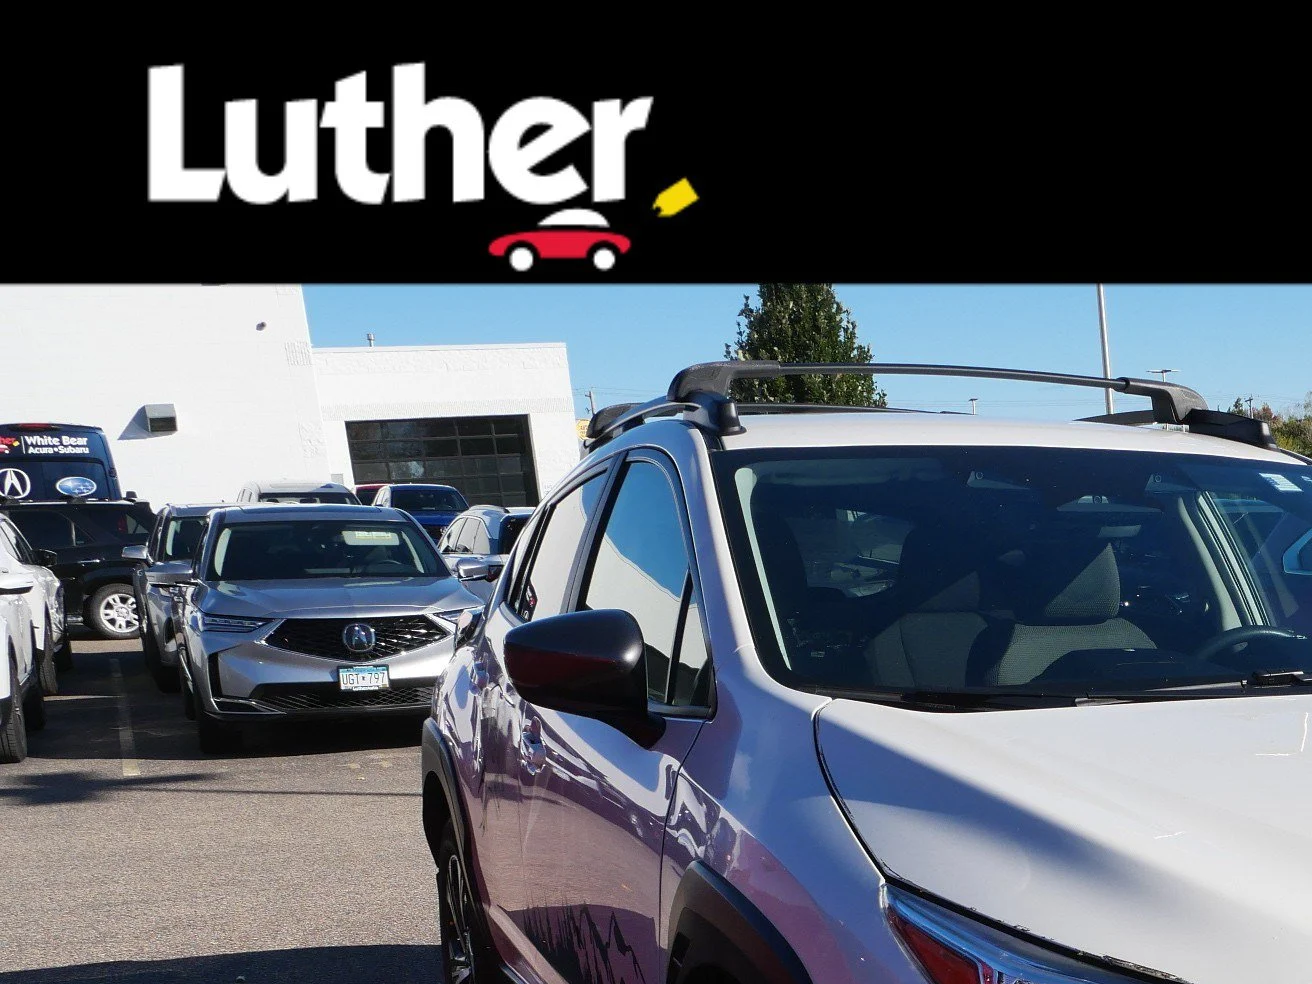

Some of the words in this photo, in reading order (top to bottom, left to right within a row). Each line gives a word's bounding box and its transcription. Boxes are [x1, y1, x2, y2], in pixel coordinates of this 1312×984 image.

[25, 435, 60, 446] White
[62, 435, 88, 446] Bear
[342, 673, 359, 685] UGT
[367, 672, 386, 684] 797
